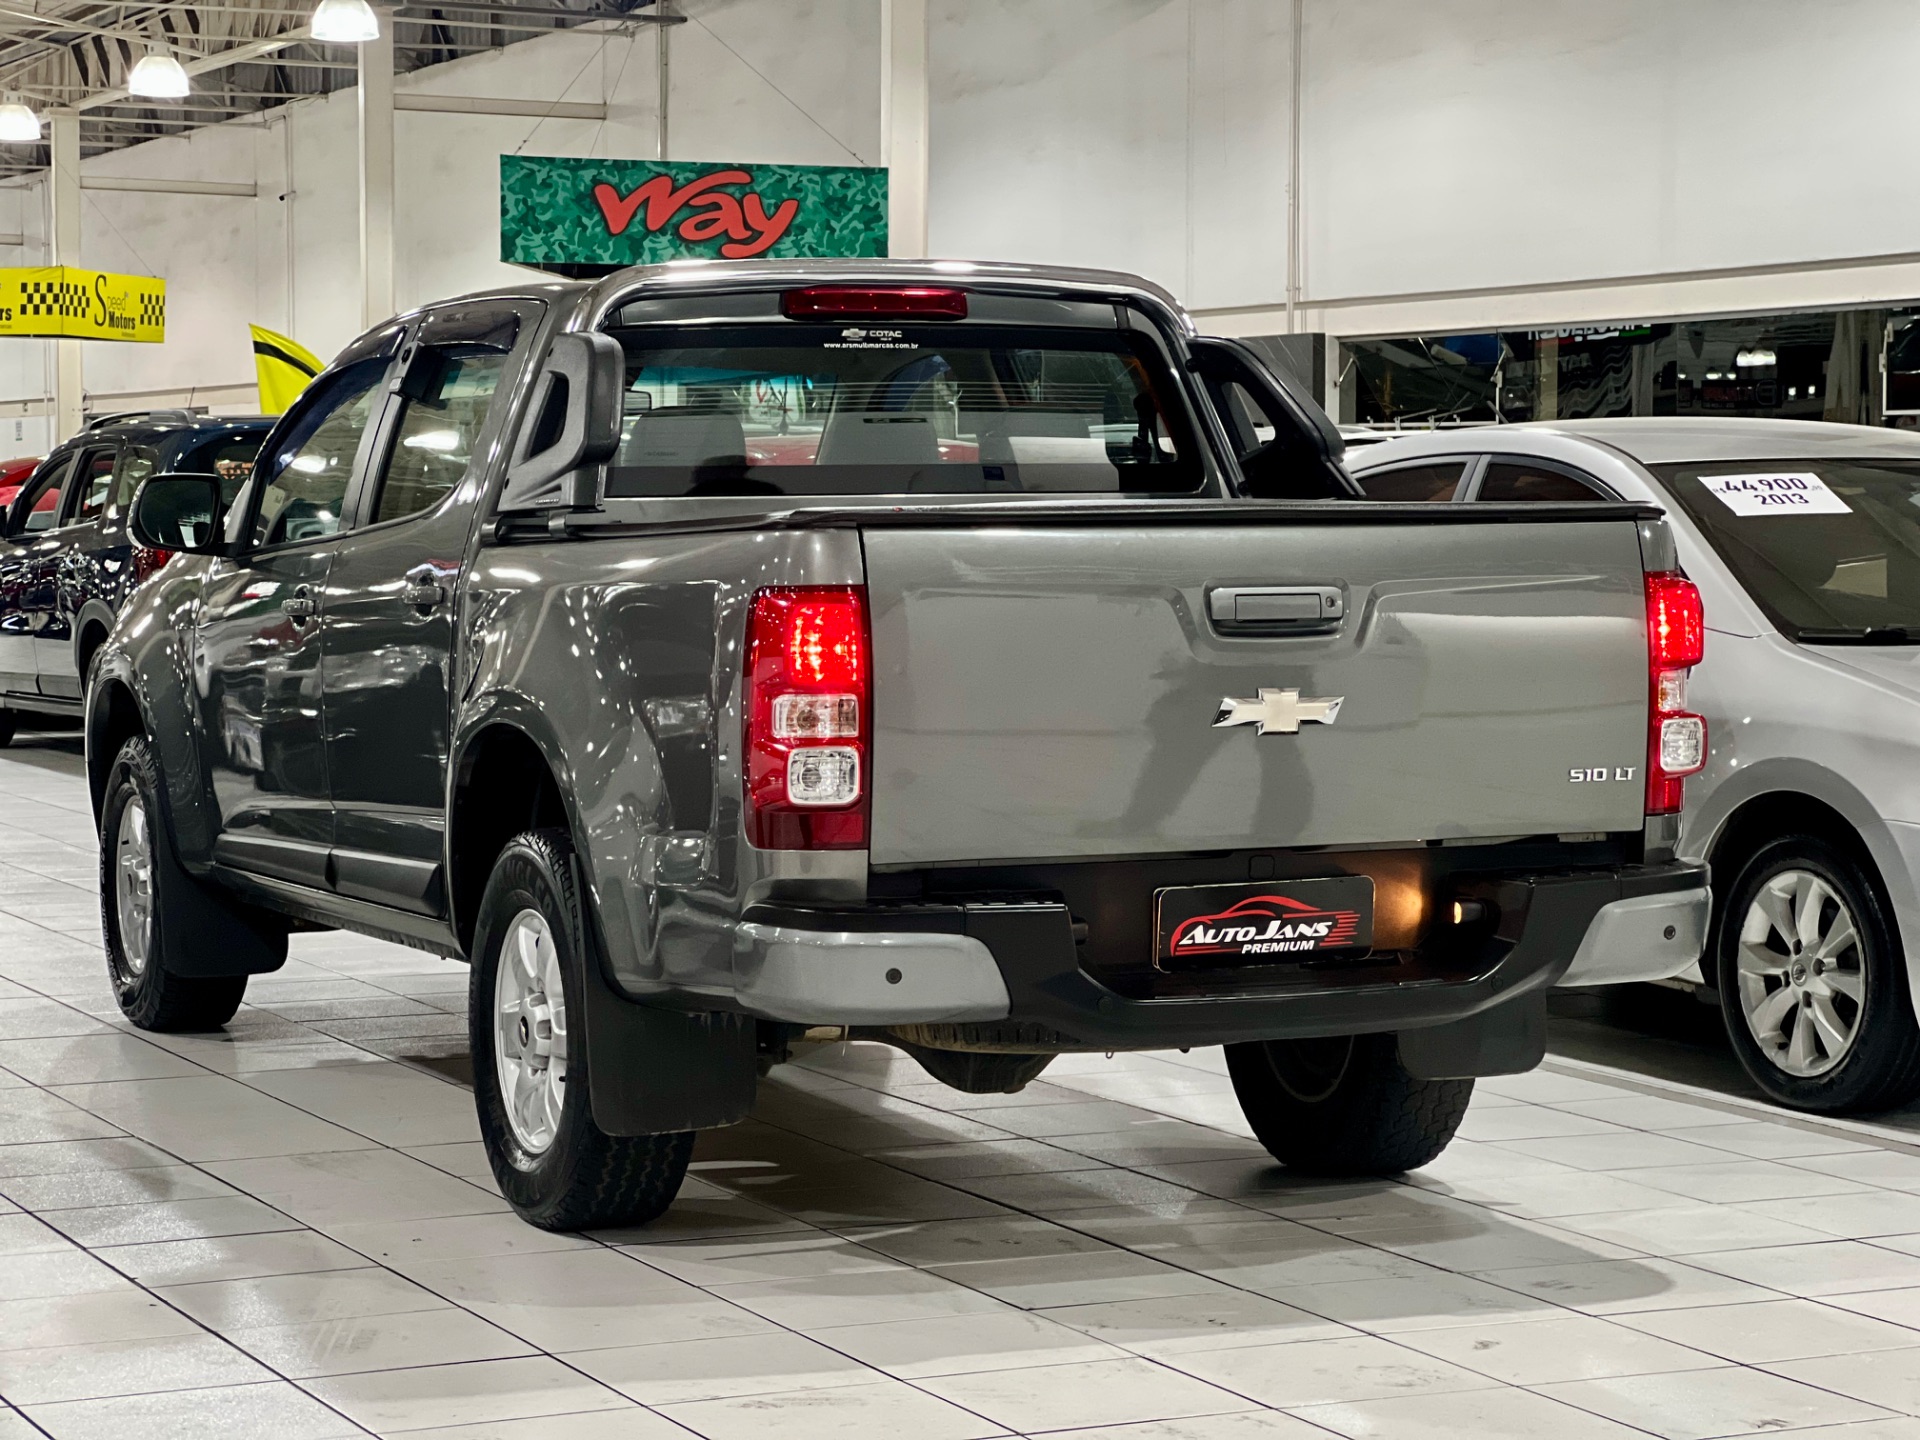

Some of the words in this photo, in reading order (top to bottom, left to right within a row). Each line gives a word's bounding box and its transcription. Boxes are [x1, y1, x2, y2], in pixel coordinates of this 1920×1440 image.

[108, 312, 136, 330] Motors
[869, 330, 903, 338] COTAC
[1753, 493, 1810, 506] 2013
[1614, 766, 1637, 781] LT
[1241, 940, 1315, 955] PREMIUM
